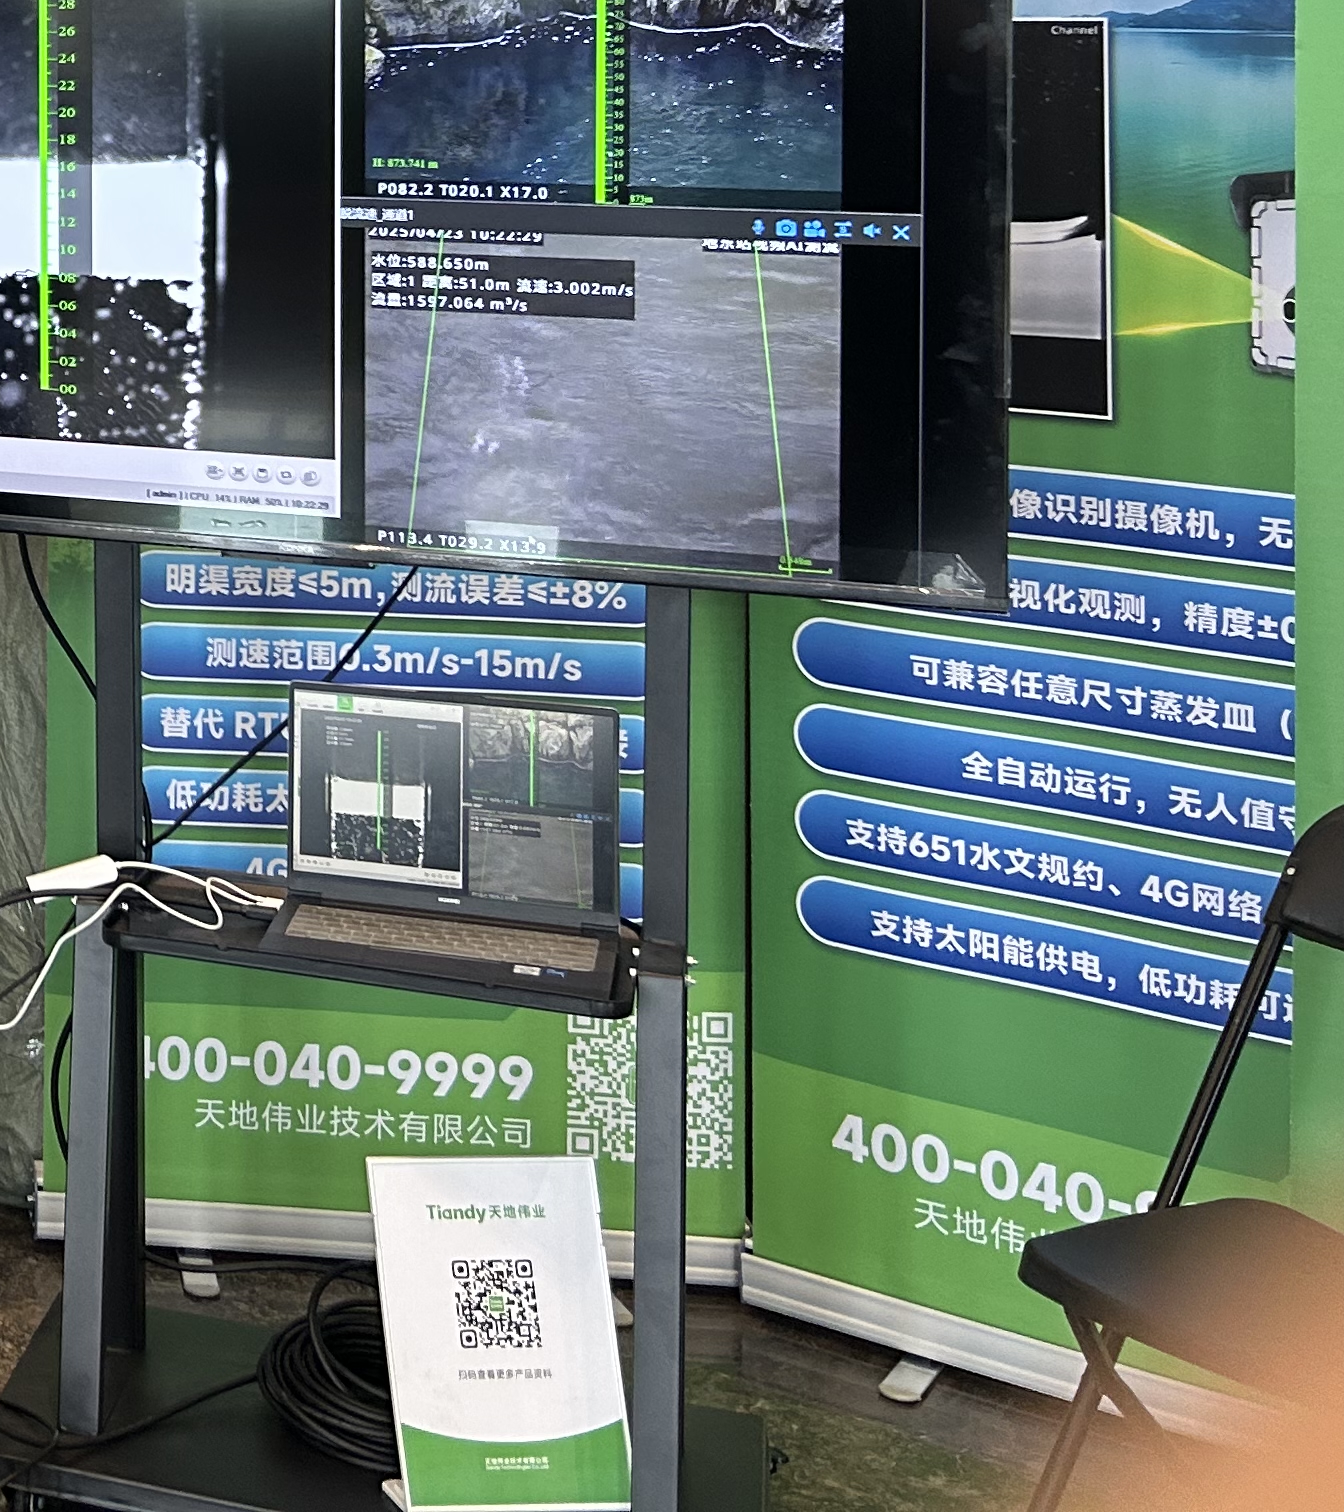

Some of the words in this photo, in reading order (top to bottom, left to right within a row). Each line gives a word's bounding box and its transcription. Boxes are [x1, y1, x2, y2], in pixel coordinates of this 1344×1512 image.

[58, 0, 76, 10] 28
[58, 26, 76, 37] 26
[1050, 25, 1098, 36] Channel
[58, 53, 76, 64] 24
[58, 80, 76, 91] 22
[58, 107, 76, 118] 20
[59, 134, 76, 145] 18
[59, 160, 76, 171] 16
[59, 188, 76, 199] 14
[377, 182, 434, 196] P082.2
[439, 184, 493, 197] T020.1
[500, 185, 549, 200] X17.0
[59, 217, 76, 227] 12
[59, 244, 76, 254] 10
[371, 253, 489, 271] 水位:588.650m
[58, 273, 77, 283] 08
[58, 300, 77, 311] 06
[58, 328, 77, 339] 04
[58, 356, 77, 367] 02
[58, 384, 77, 395] 00
[377, 529, 433, 547] P113.4
[438, 534, 493, 550] T029.2
[499, 538, 546, 555] X13.9
[160, 706, 224, 739] 替代
[870, 909, 1292, 1025] 支持太阳能供电，低功耗可
[195, 1098, 532, 1149] 天地伟业技术有限公司
[425, 1204, 486, 1224] Tiandy
[489, 1204, 546, 1219] 天地伟业
[914, 1198, 1055, 1254] 天地伟
